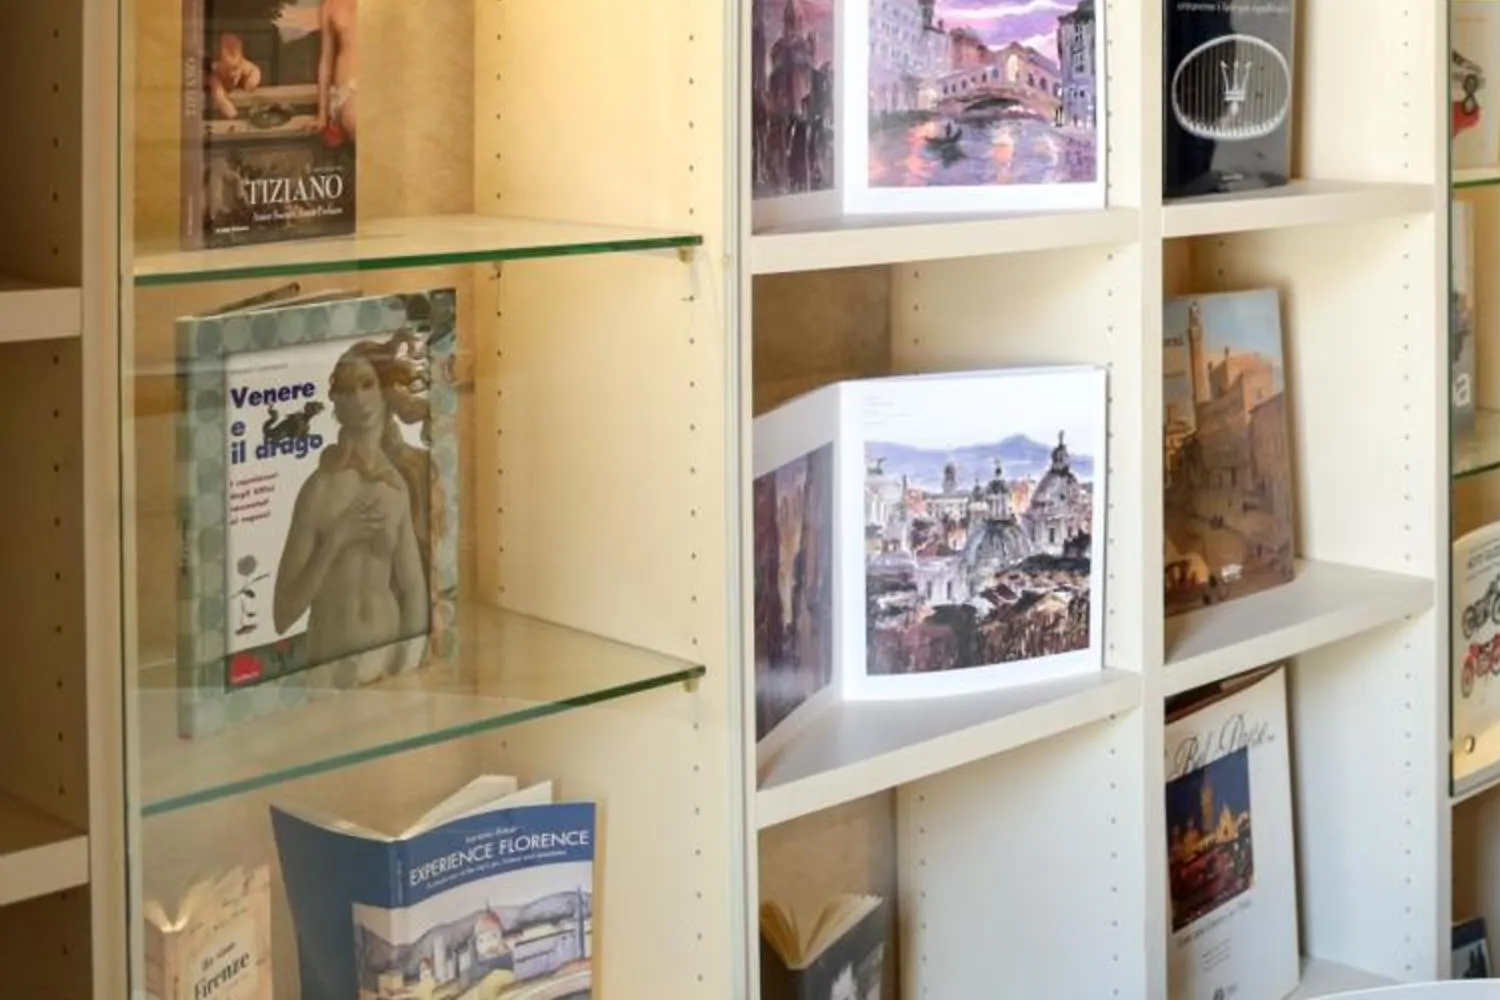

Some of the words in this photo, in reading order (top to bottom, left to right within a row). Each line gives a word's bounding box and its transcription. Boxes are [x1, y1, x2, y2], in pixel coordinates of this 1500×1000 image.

[244, 173, 343, 205] TIZIANO
[230, 381, 316, 409] Venere
[231, 421, 246, 437] e
[232, 440, 246, 464] il
[255, 433, 324, 460] drago
[409, 841, 495, 888] EXPERIENCE
[499, 829, 590, 855] FLORENCE
